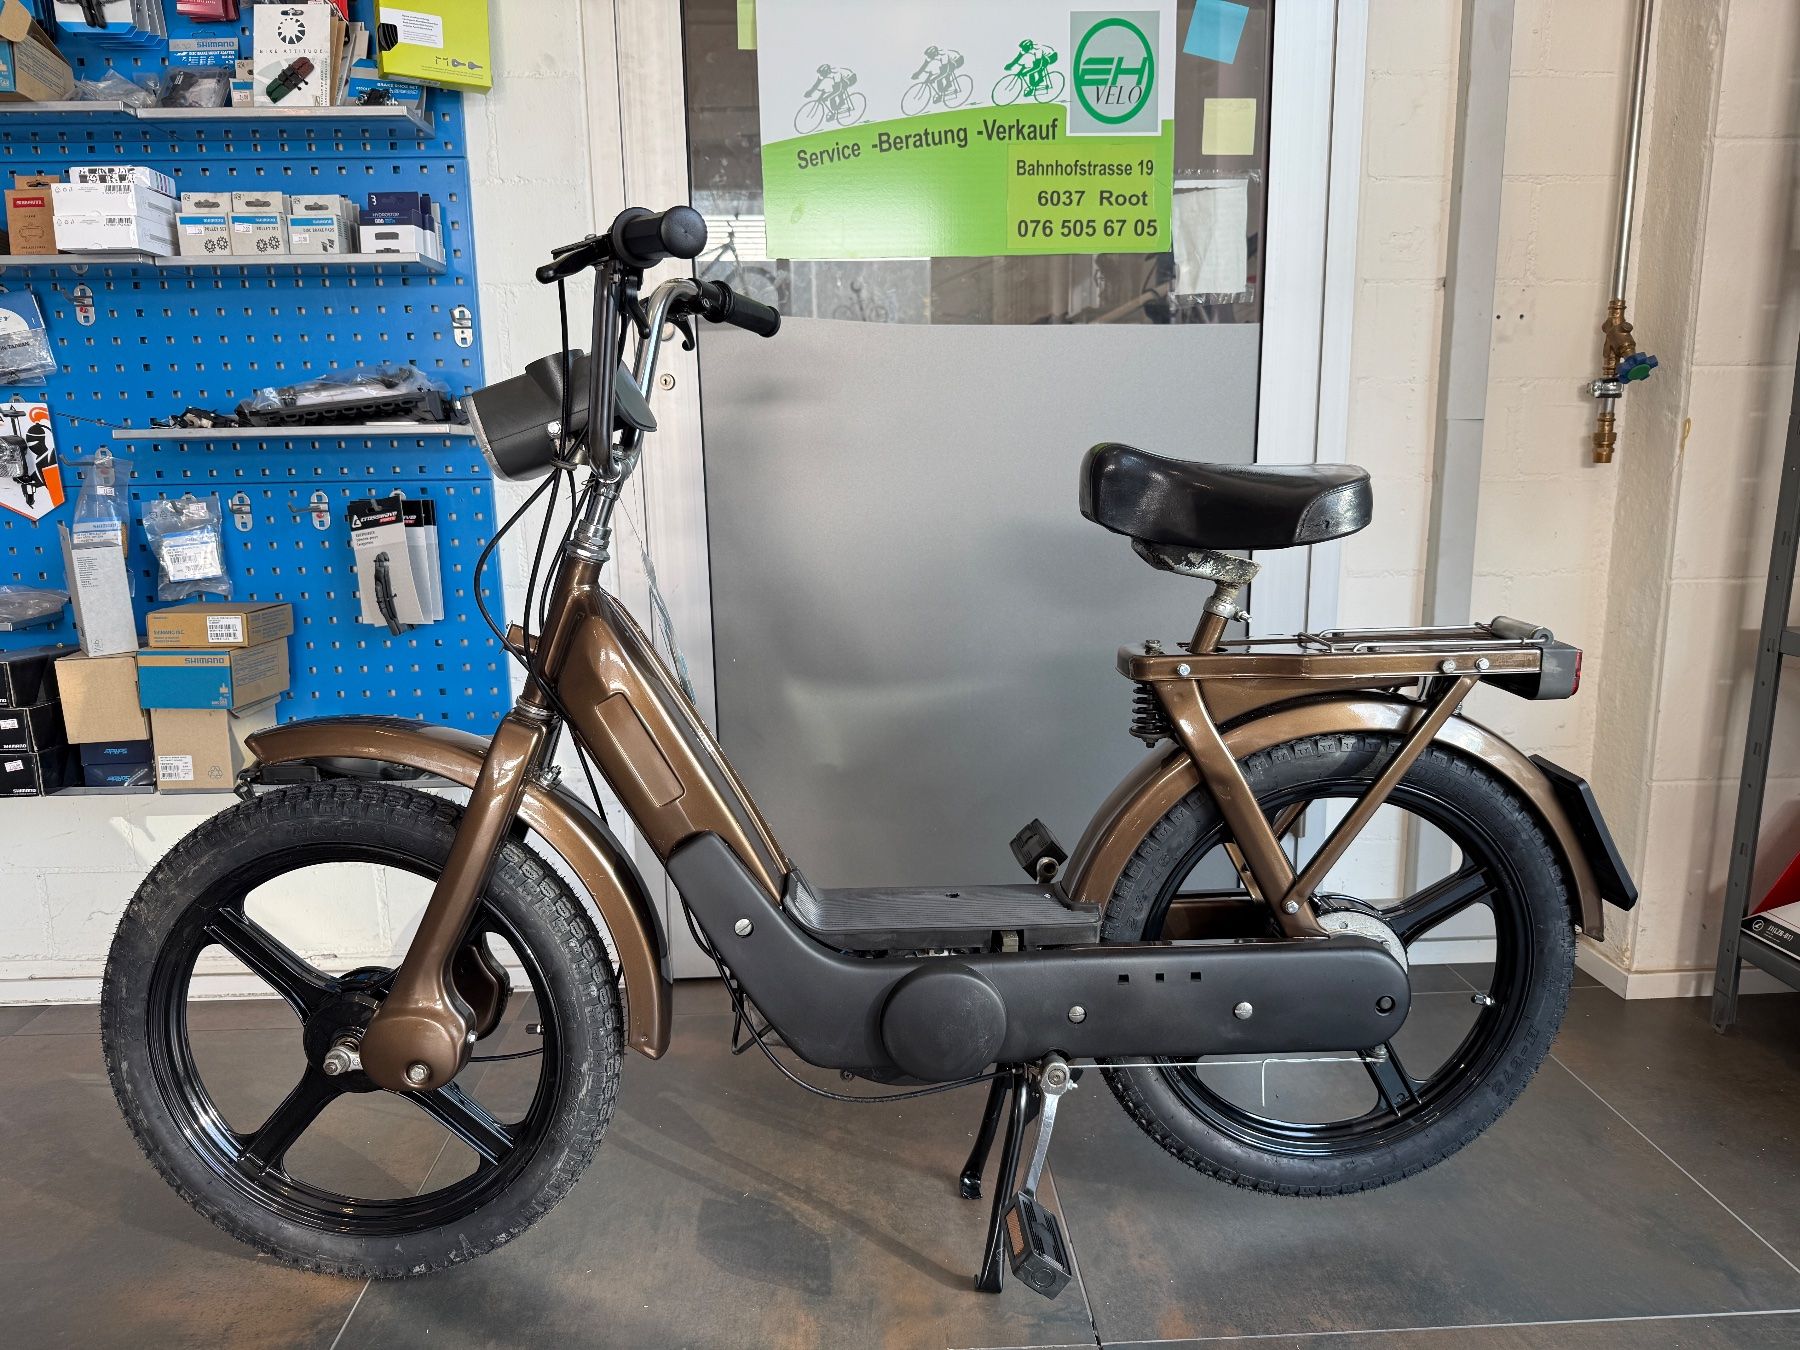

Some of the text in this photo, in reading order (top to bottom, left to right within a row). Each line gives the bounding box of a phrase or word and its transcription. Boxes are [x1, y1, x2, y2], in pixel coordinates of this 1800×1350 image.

[1094, 85, 1142, 105] VELO
[797, 118, 1059, 170] Service -Beratung -Verkauf
[1016, 159, 1154, 176] Bahnhofstrasse 19
[1037, 190, 1148, 207] 6037 Root
[1017, 219, 1158, 238] 076 505 67 05
